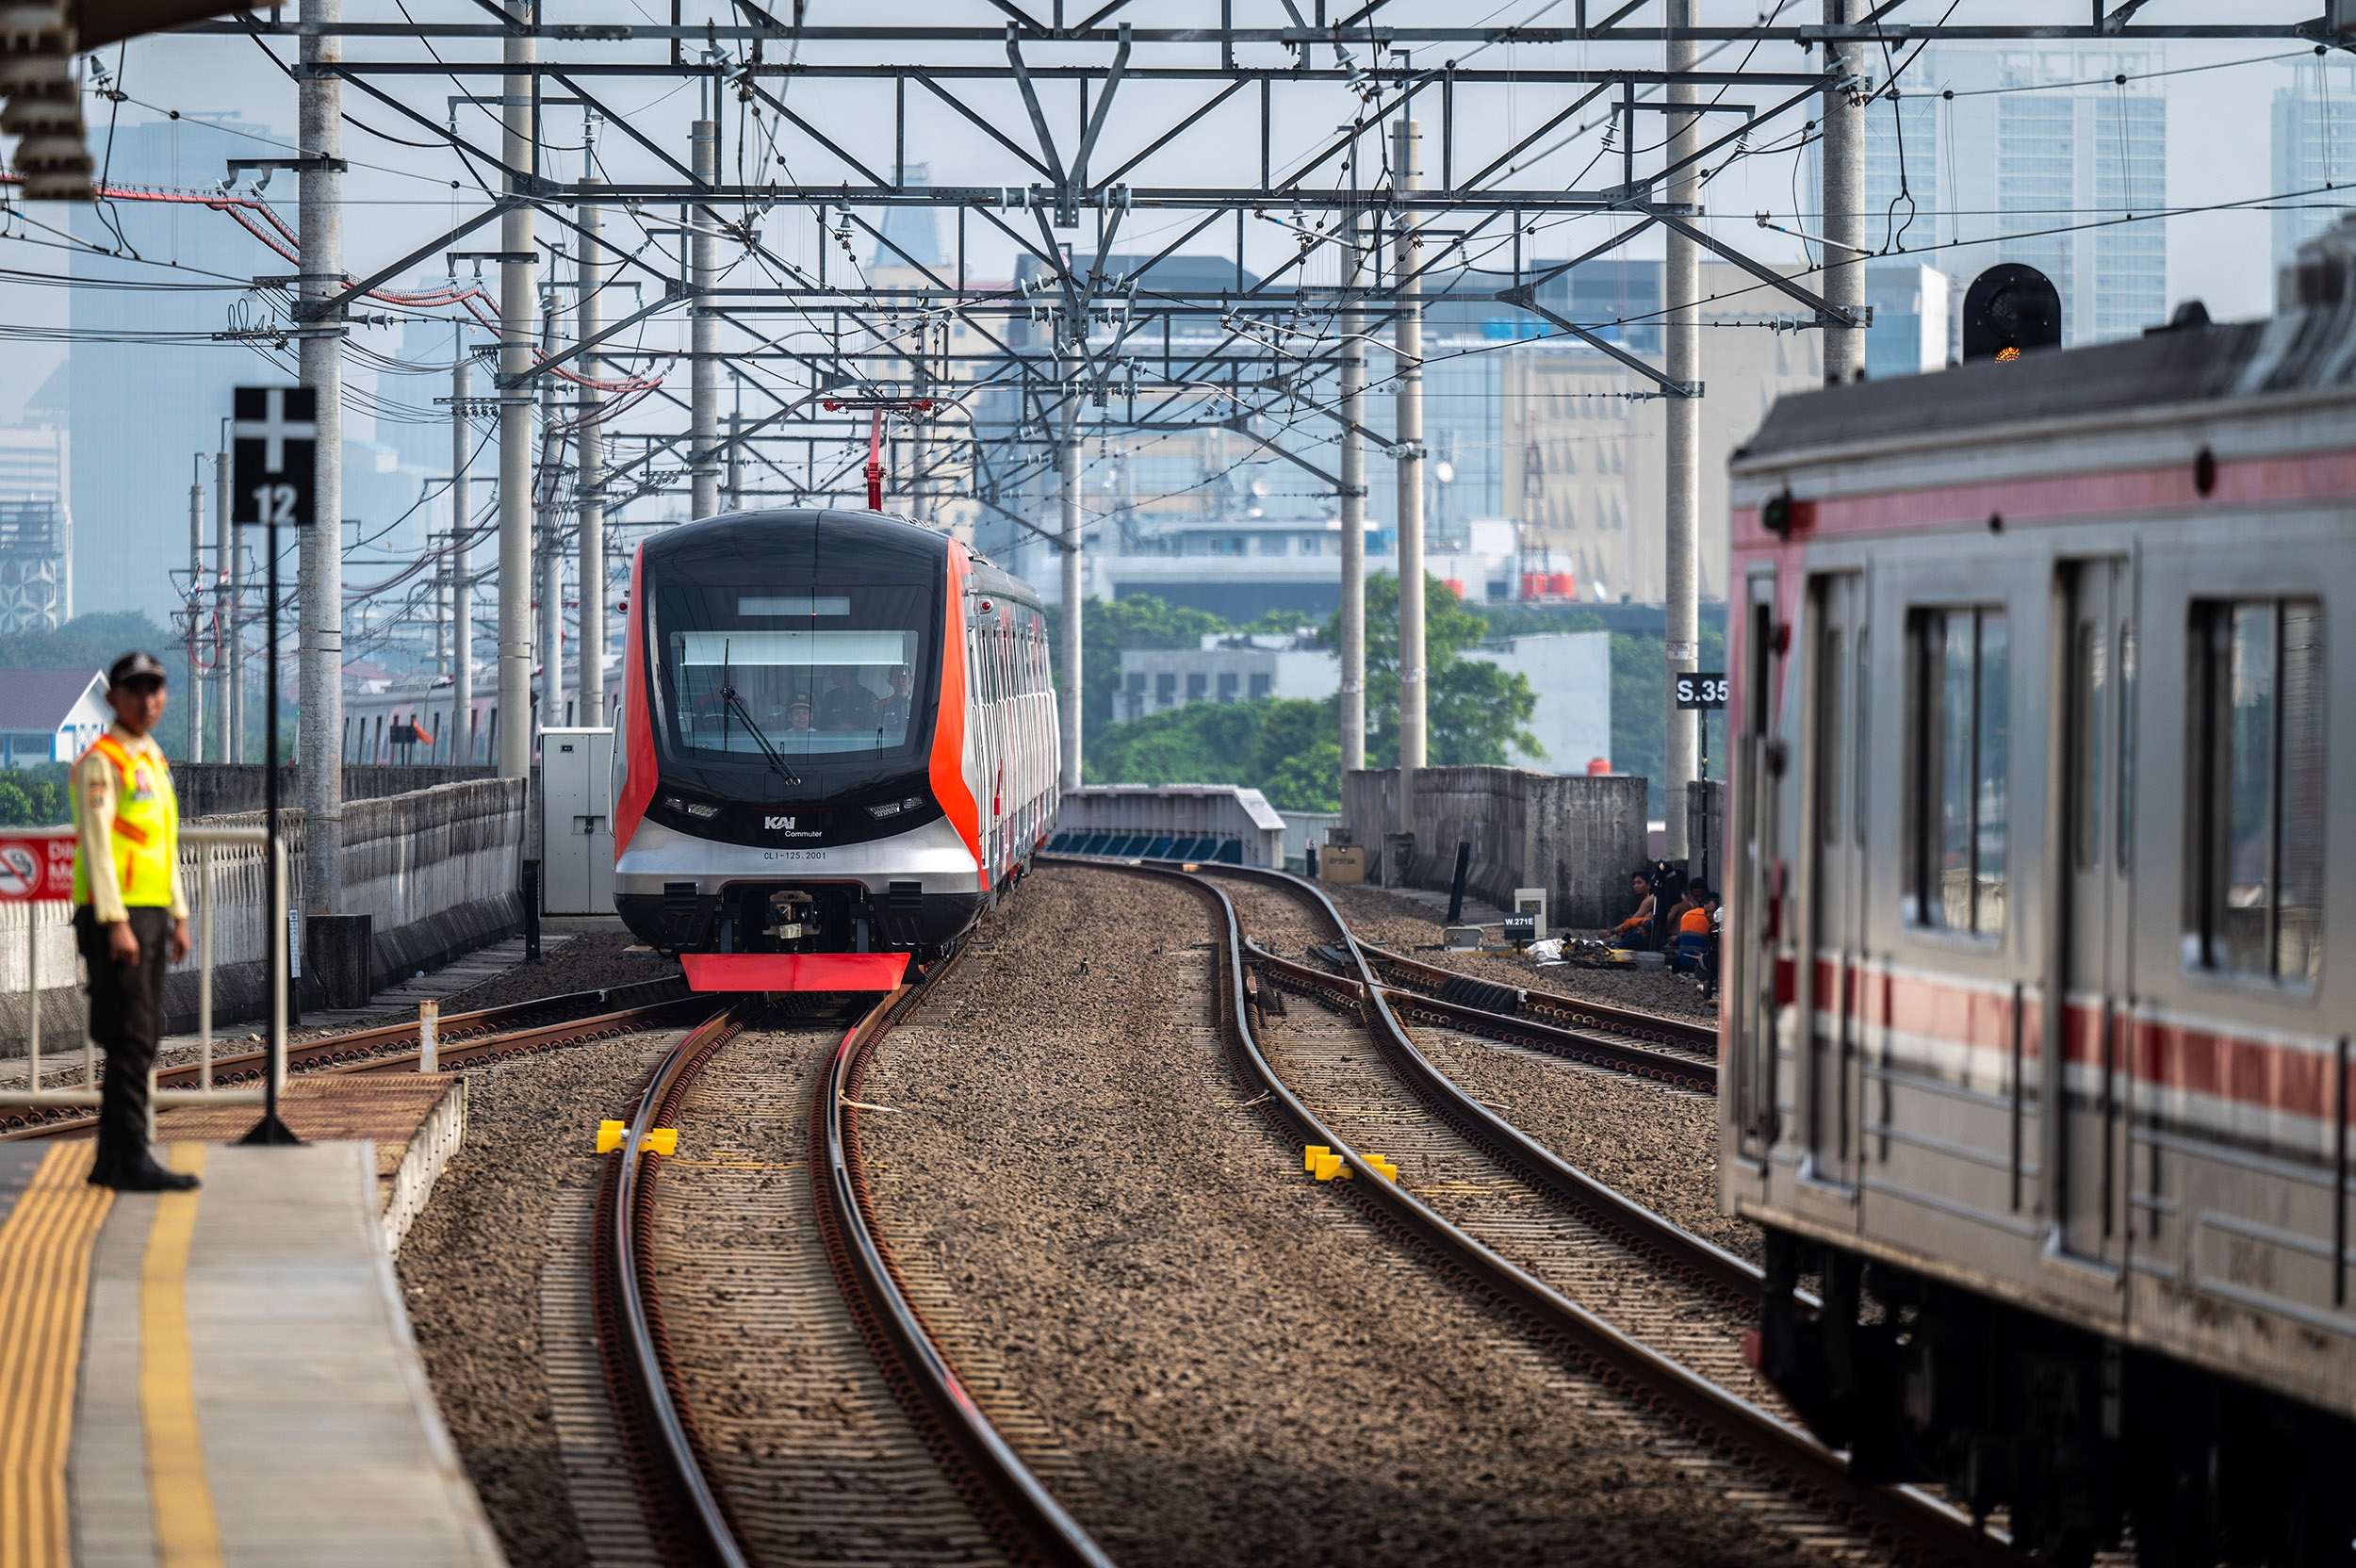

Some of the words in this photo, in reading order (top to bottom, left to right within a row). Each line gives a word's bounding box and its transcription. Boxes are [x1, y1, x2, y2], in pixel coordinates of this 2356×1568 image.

[252, 482, 298, 525] 12
[1677, 679, 1729, 702] S.35
[764, 816, 795, 829] KAI
[763, 851, 826, 860] CLI-125.2001
[1504, 917, 1534, 926] W.271E
